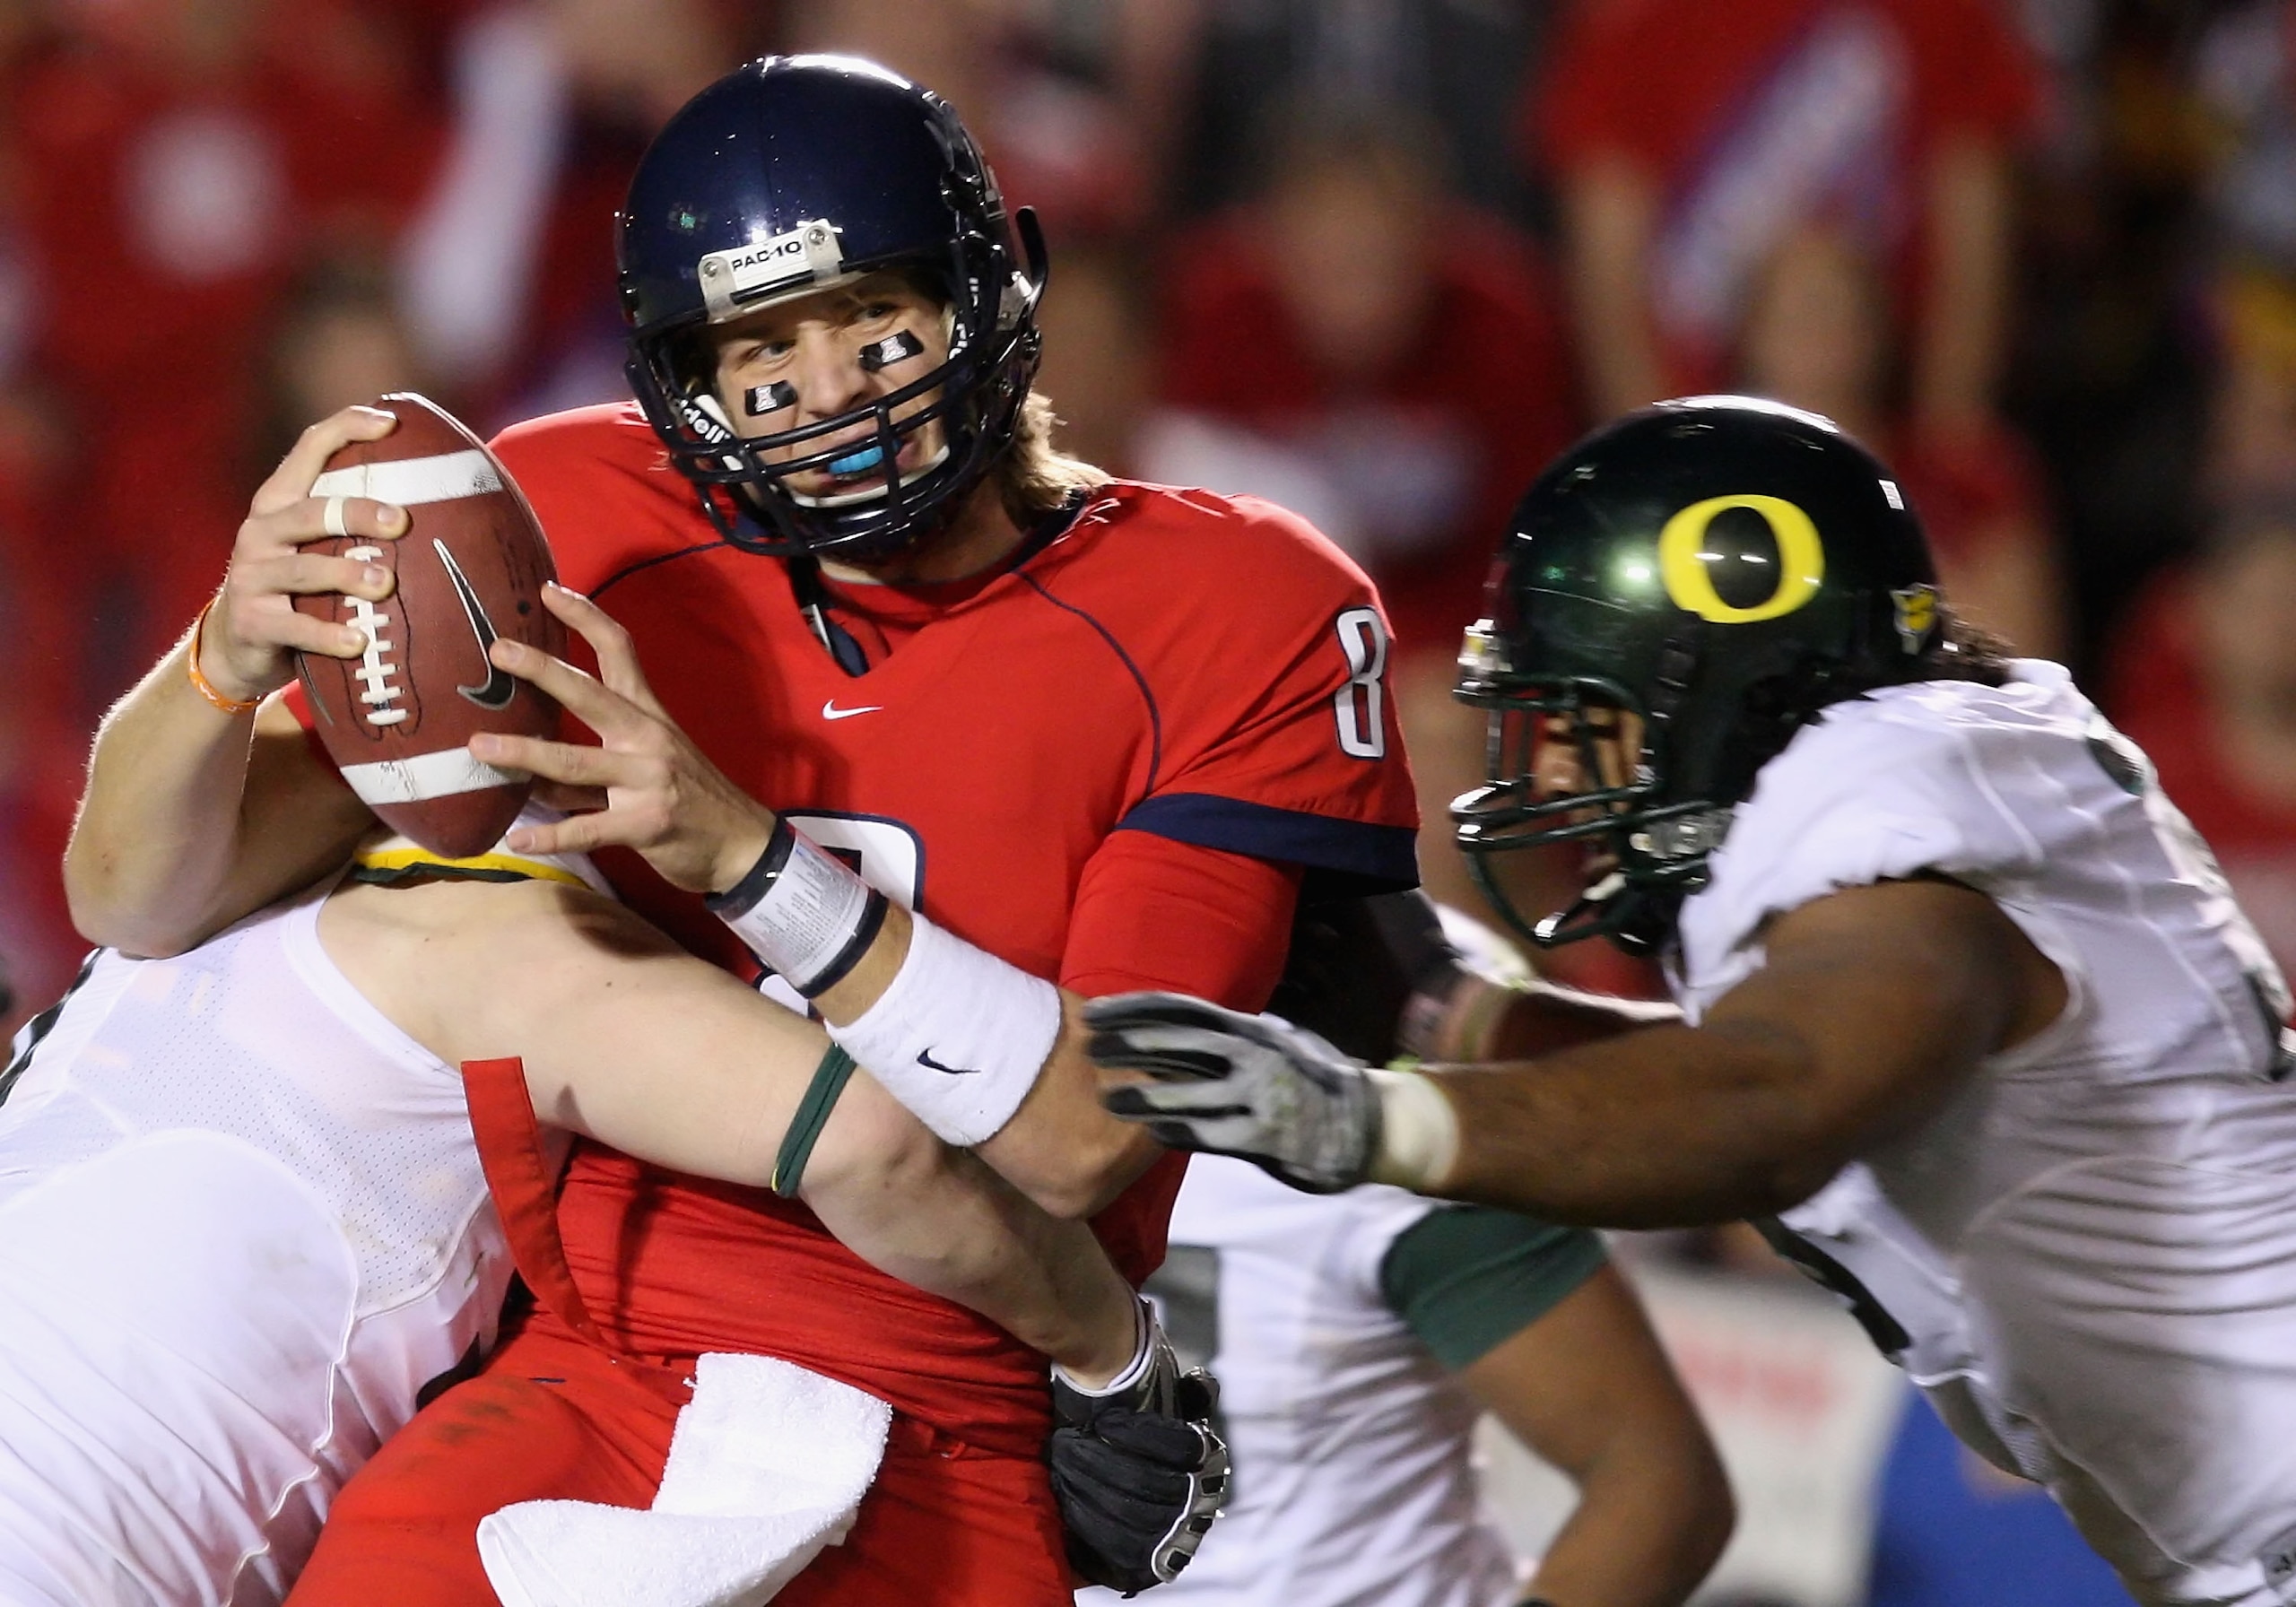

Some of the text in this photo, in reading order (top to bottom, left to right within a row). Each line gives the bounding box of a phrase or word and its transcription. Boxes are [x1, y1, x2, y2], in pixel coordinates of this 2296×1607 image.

[731, 240, 803, 272] PAC-10
[1658, 493, 1825, 624] O
[1334, 605, 1387, 760] 8
